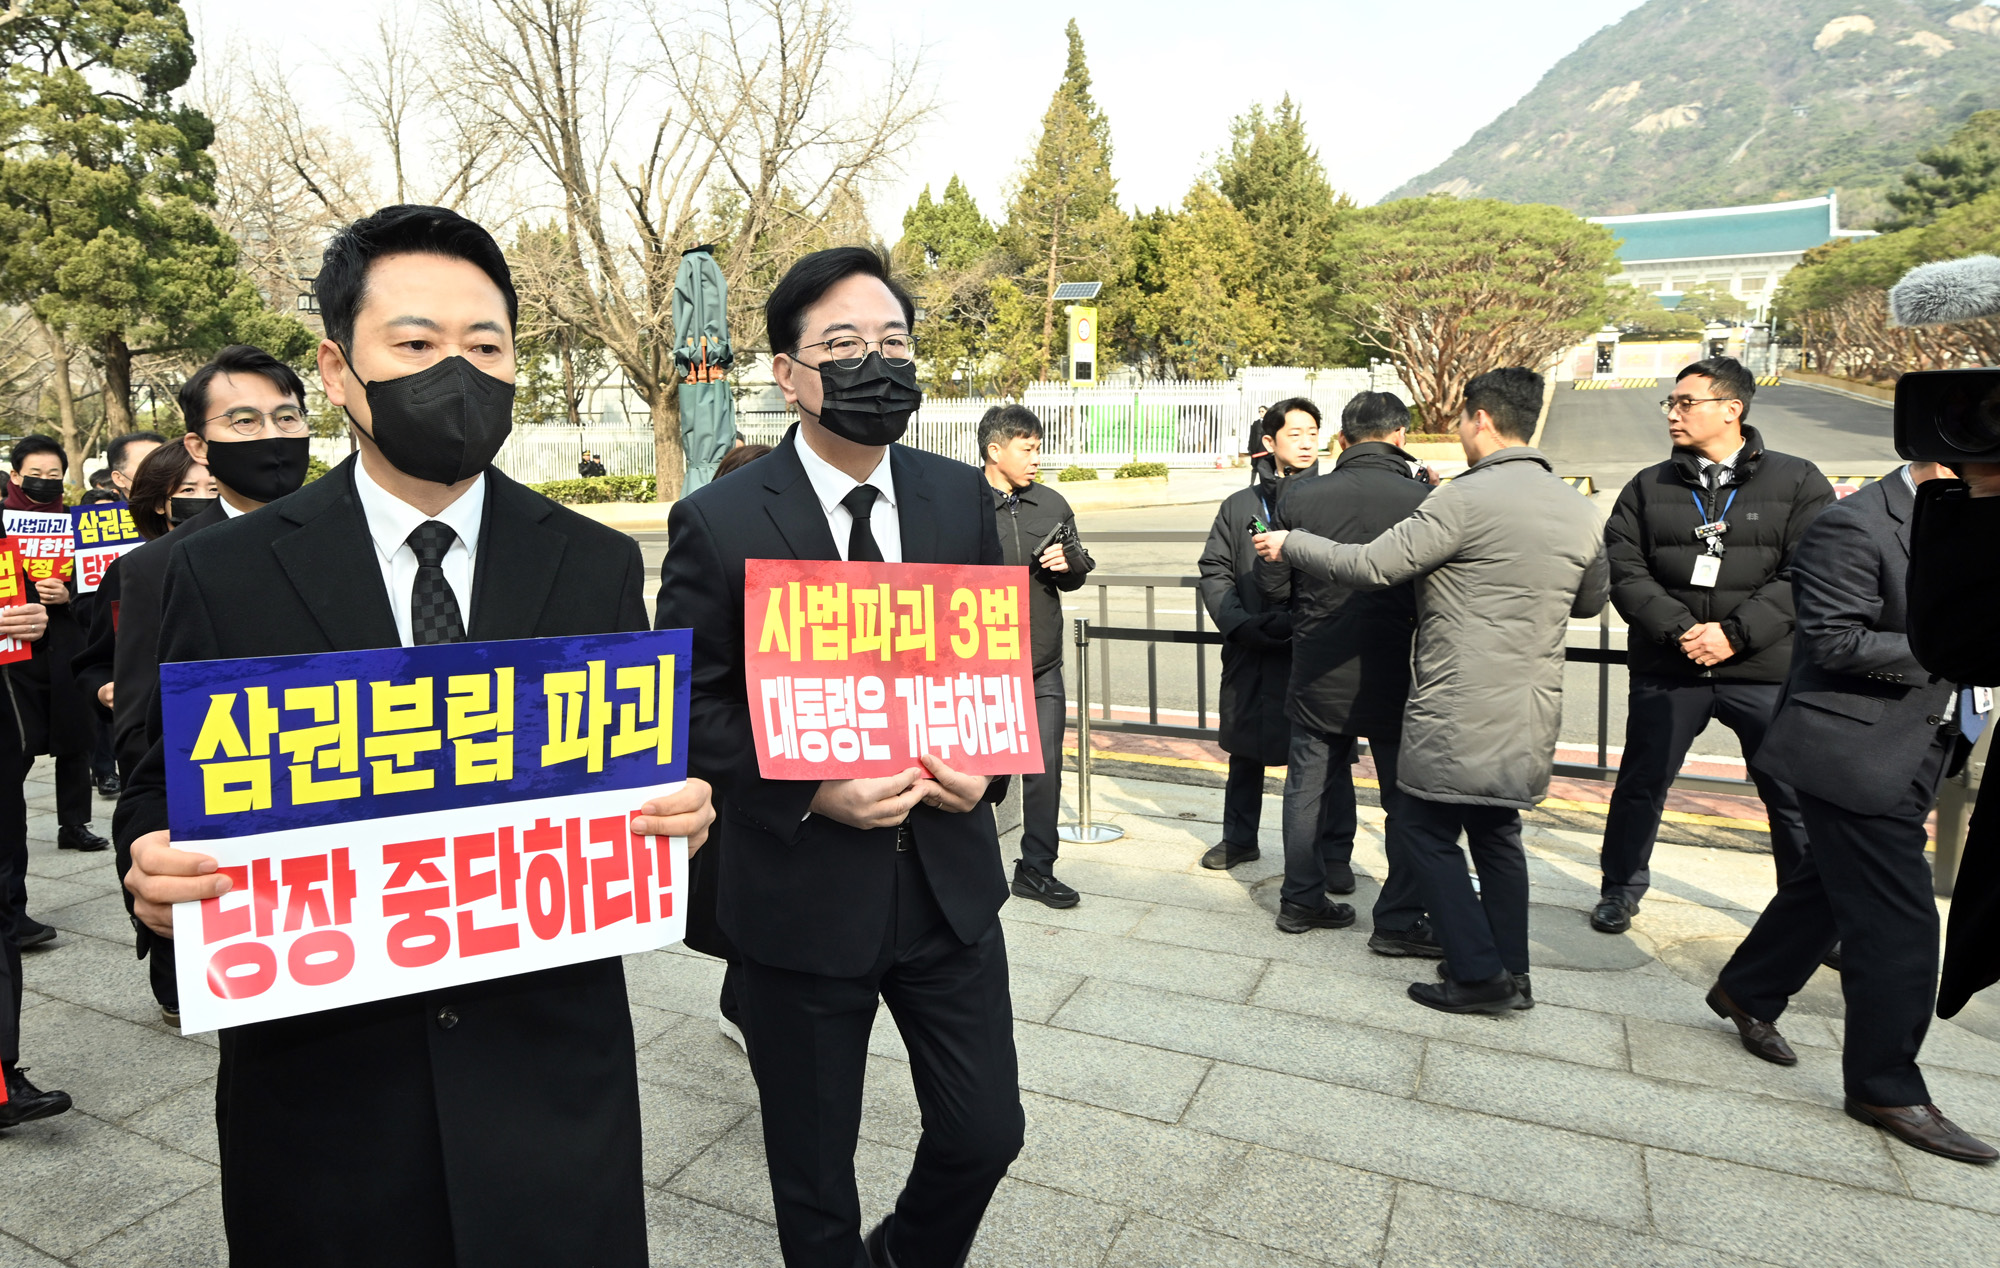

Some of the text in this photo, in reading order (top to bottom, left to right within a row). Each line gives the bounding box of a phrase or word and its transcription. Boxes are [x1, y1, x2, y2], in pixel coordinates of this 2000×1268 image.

[7, 518, 67, 533] 사법파괴
[758, 582, 1020, 662] 사법파괴 3법
[190, 654, 676, 815] 삼권분립 파괴
[760, 672, 1029, 763] 대통령은 거부하라!
[201, 809, 674, 1000] 당장 중단하라!
